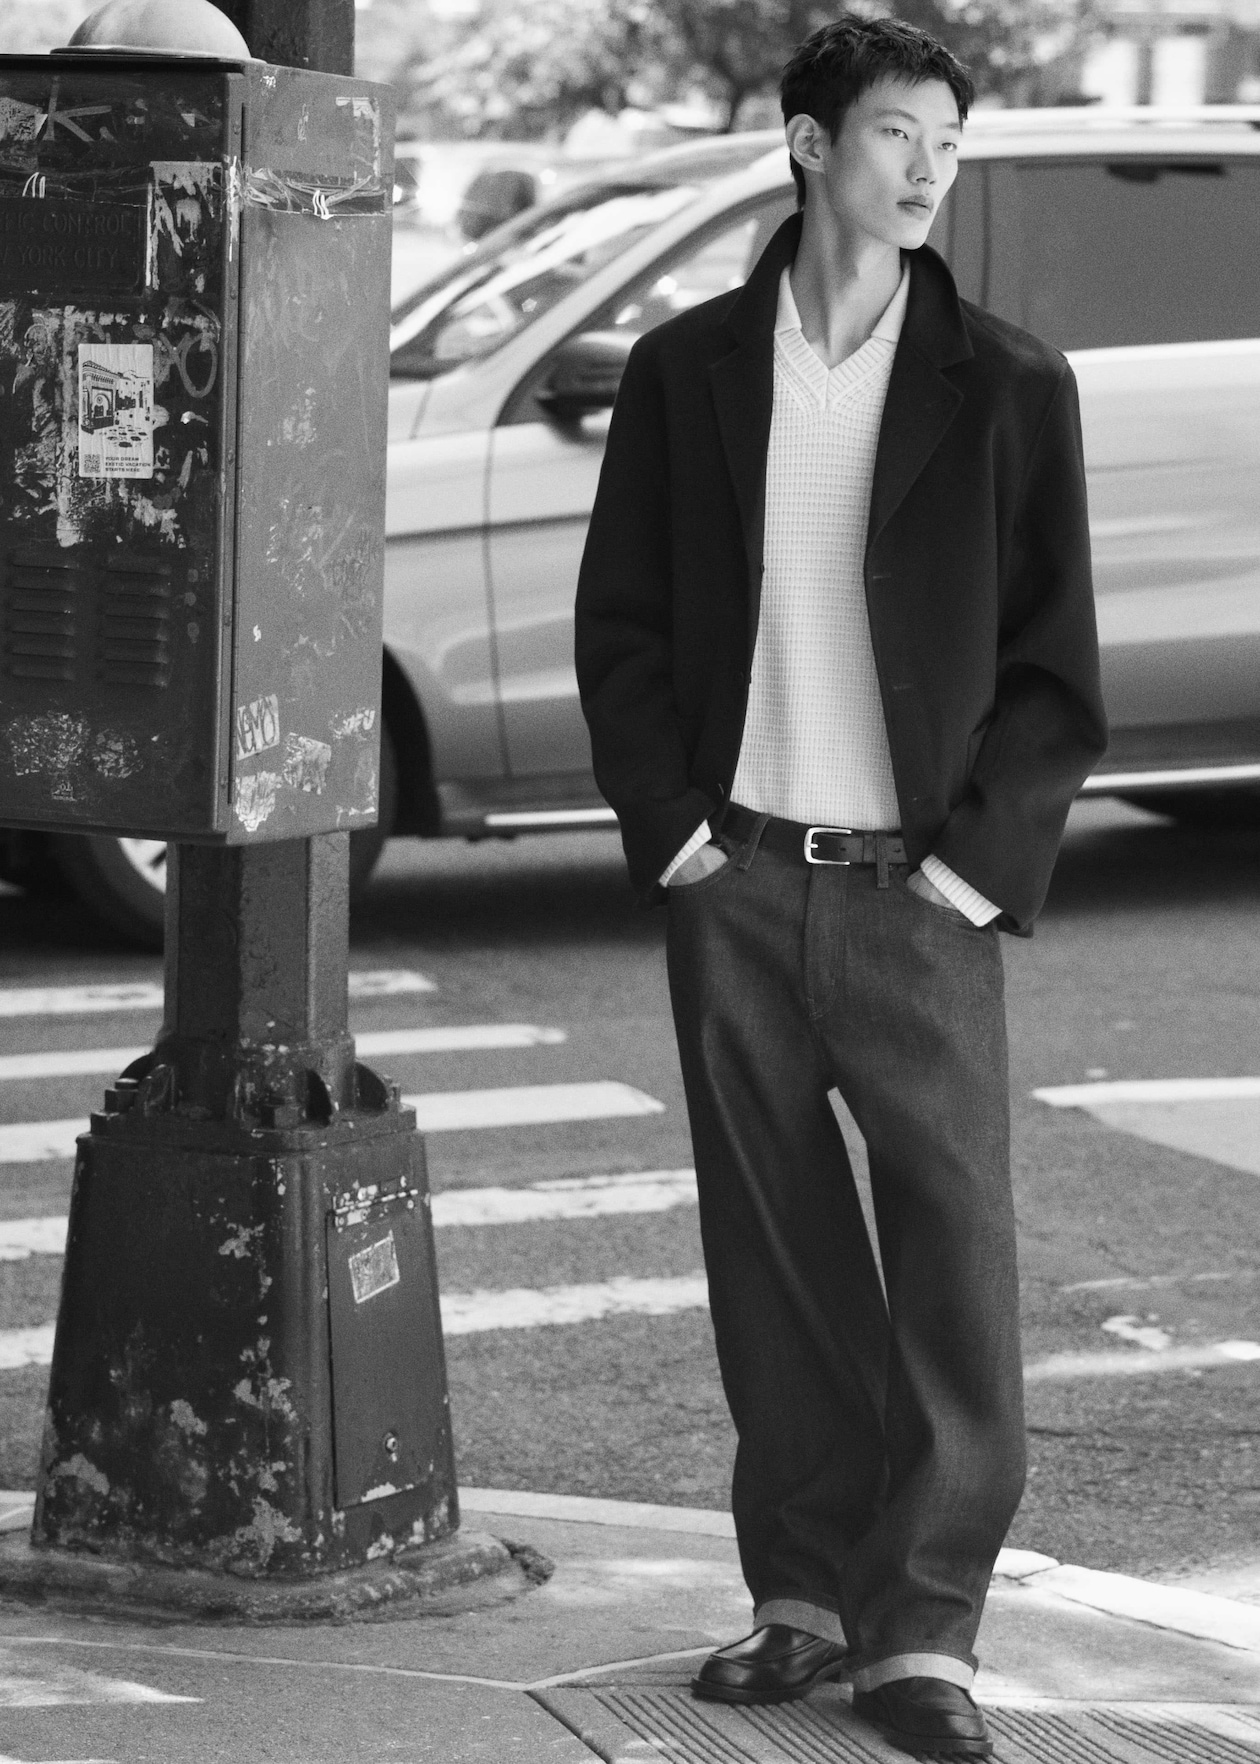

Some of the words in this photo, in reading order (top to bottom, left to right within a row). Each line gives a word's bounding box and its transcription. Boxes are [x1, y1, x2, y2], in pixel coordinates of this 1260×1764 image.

[42, 211, 132, 235] CONTROL
[17, 244, 66, 267] YORK
[73, 246, 119, 269] CITY
